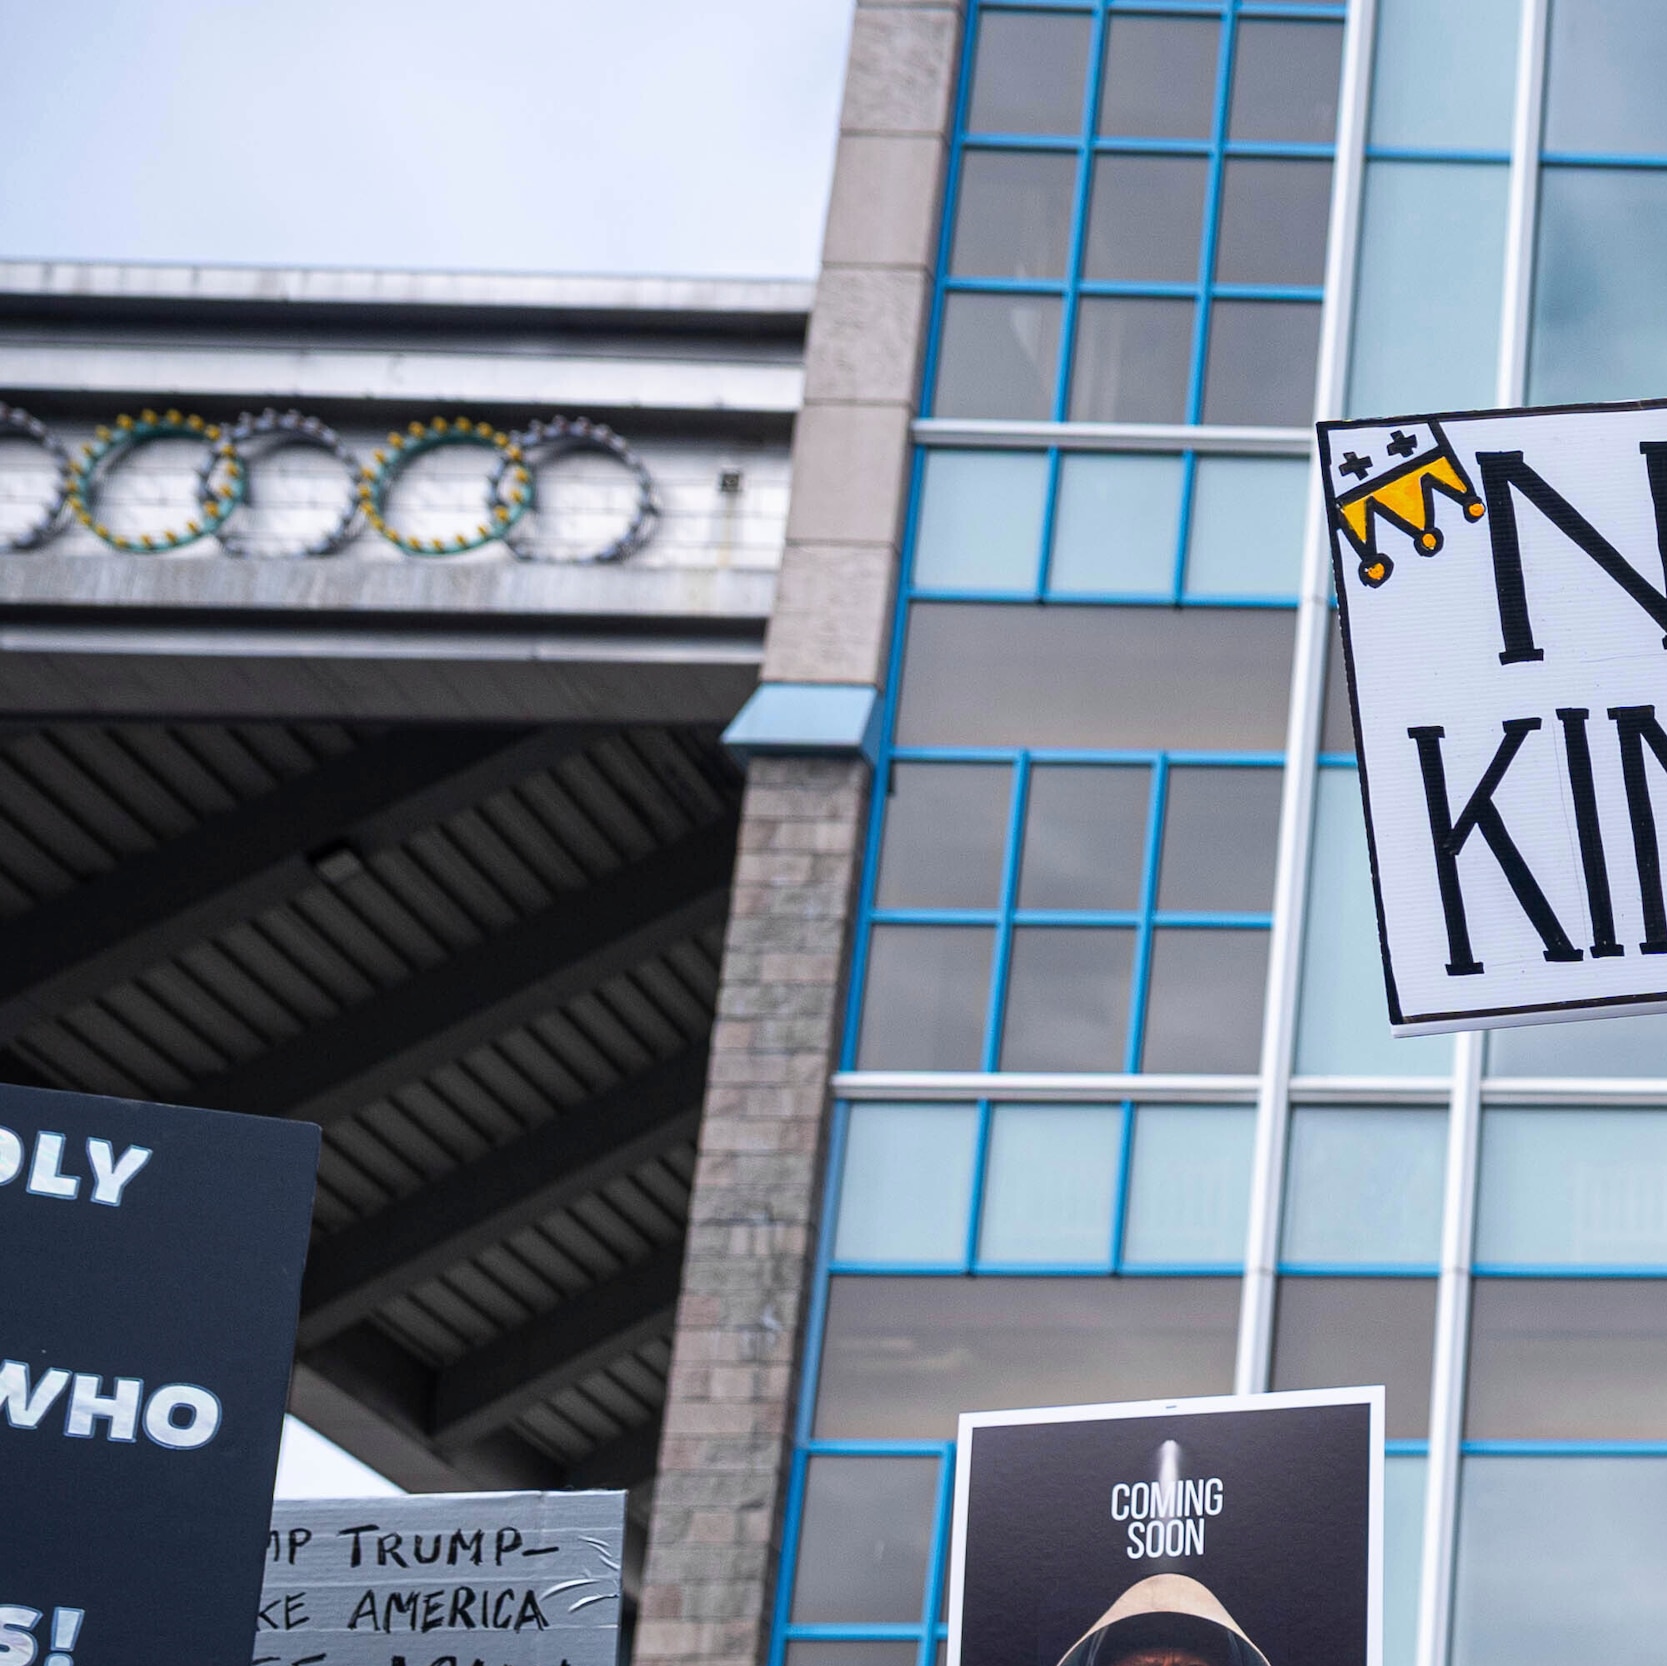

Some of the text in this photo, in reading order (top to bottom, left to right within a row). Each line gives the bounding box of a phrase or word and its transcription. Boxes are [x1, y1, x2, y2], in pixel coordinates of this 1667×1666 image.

[1111, 1477, 1225, 1522] COMING
[1126, 1518, 1206, 1560] SOON
[347, 1586, 550, 1634] AMERICA
